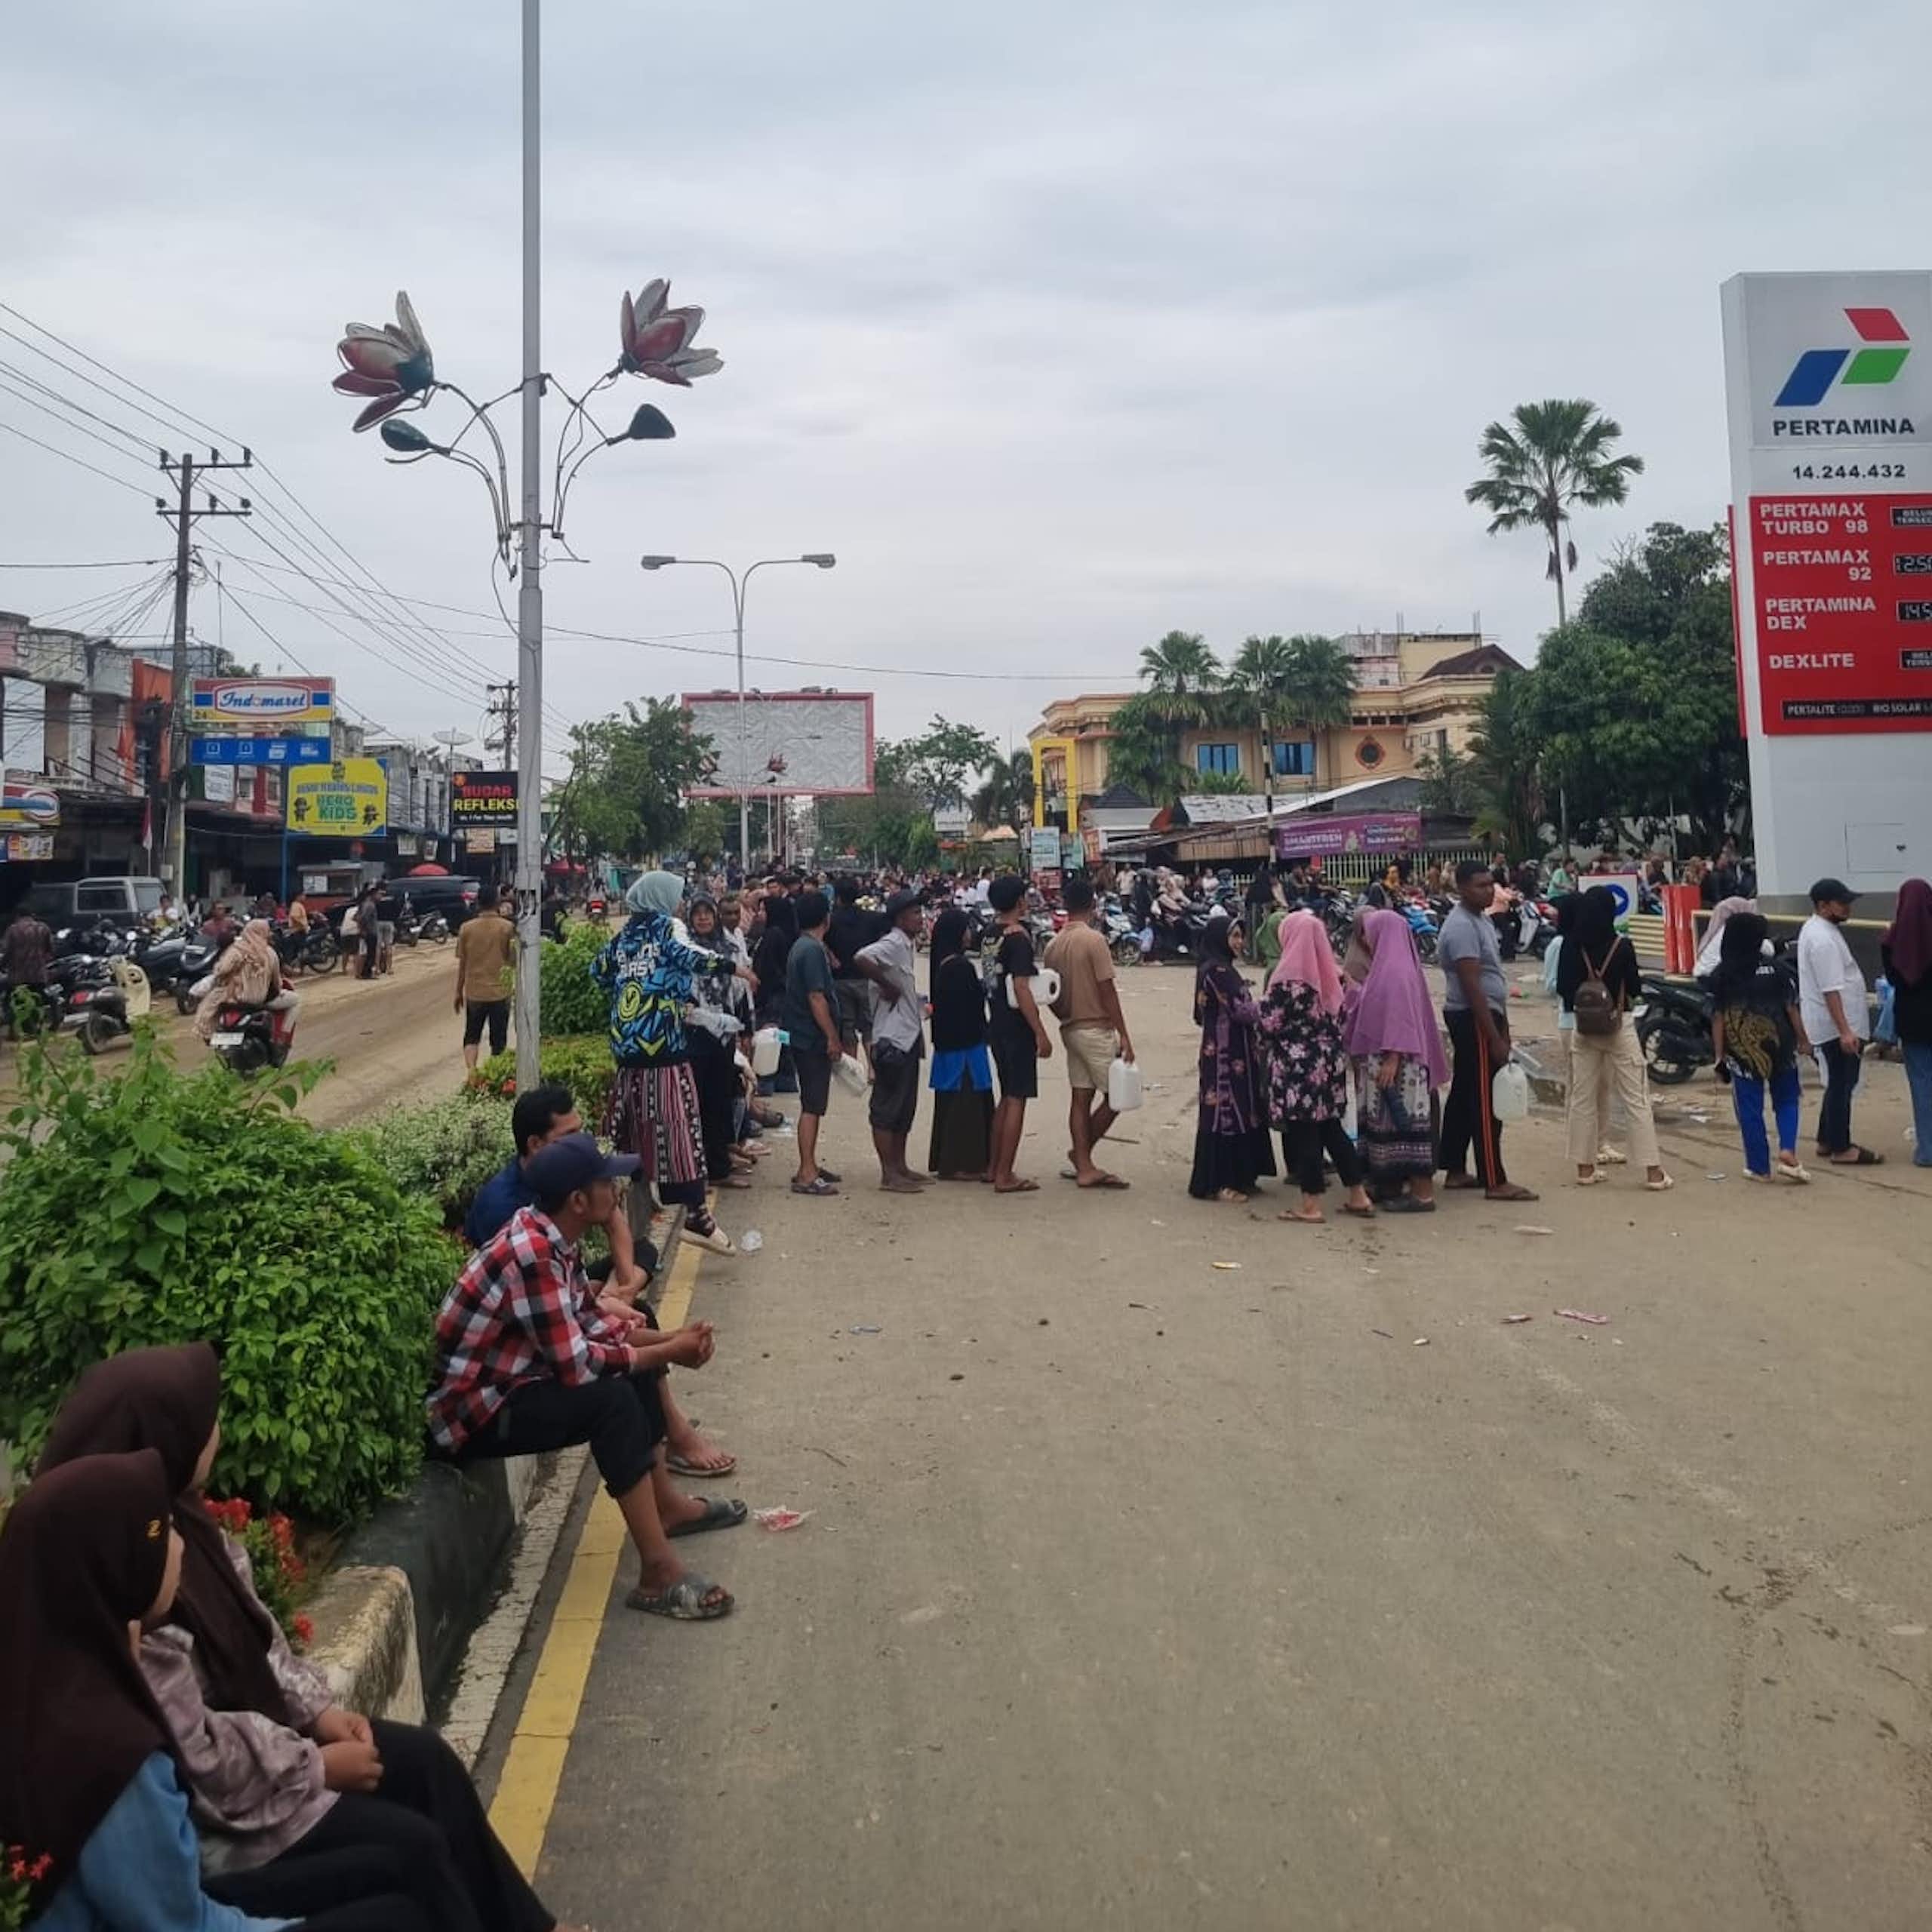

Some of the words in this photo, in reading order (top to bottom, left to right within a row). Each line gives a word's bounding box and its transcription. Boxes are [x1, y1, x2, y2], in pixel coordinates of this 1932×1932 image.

[1774, 418, 1915, 436] PERTAMINA
[1792, 464, 1906, 479] 14.244.432
[1760, 503, 1866, 518] PERTAMAX
[1762, 521, 1829, 534] TURBO
[1845, 519, 1869, 533] 98
[1763, 550, 1869, 565] PERTAMAX
[1849, 568, 1872, 580] 92
[1765, 597, 1876, 612] PERTAMINA
[1767, 616, 1807, 629] DEX
[1769, 654, 1855, 669] DEXLITE
[1787, 704, 1835, 714] PERTALITE
